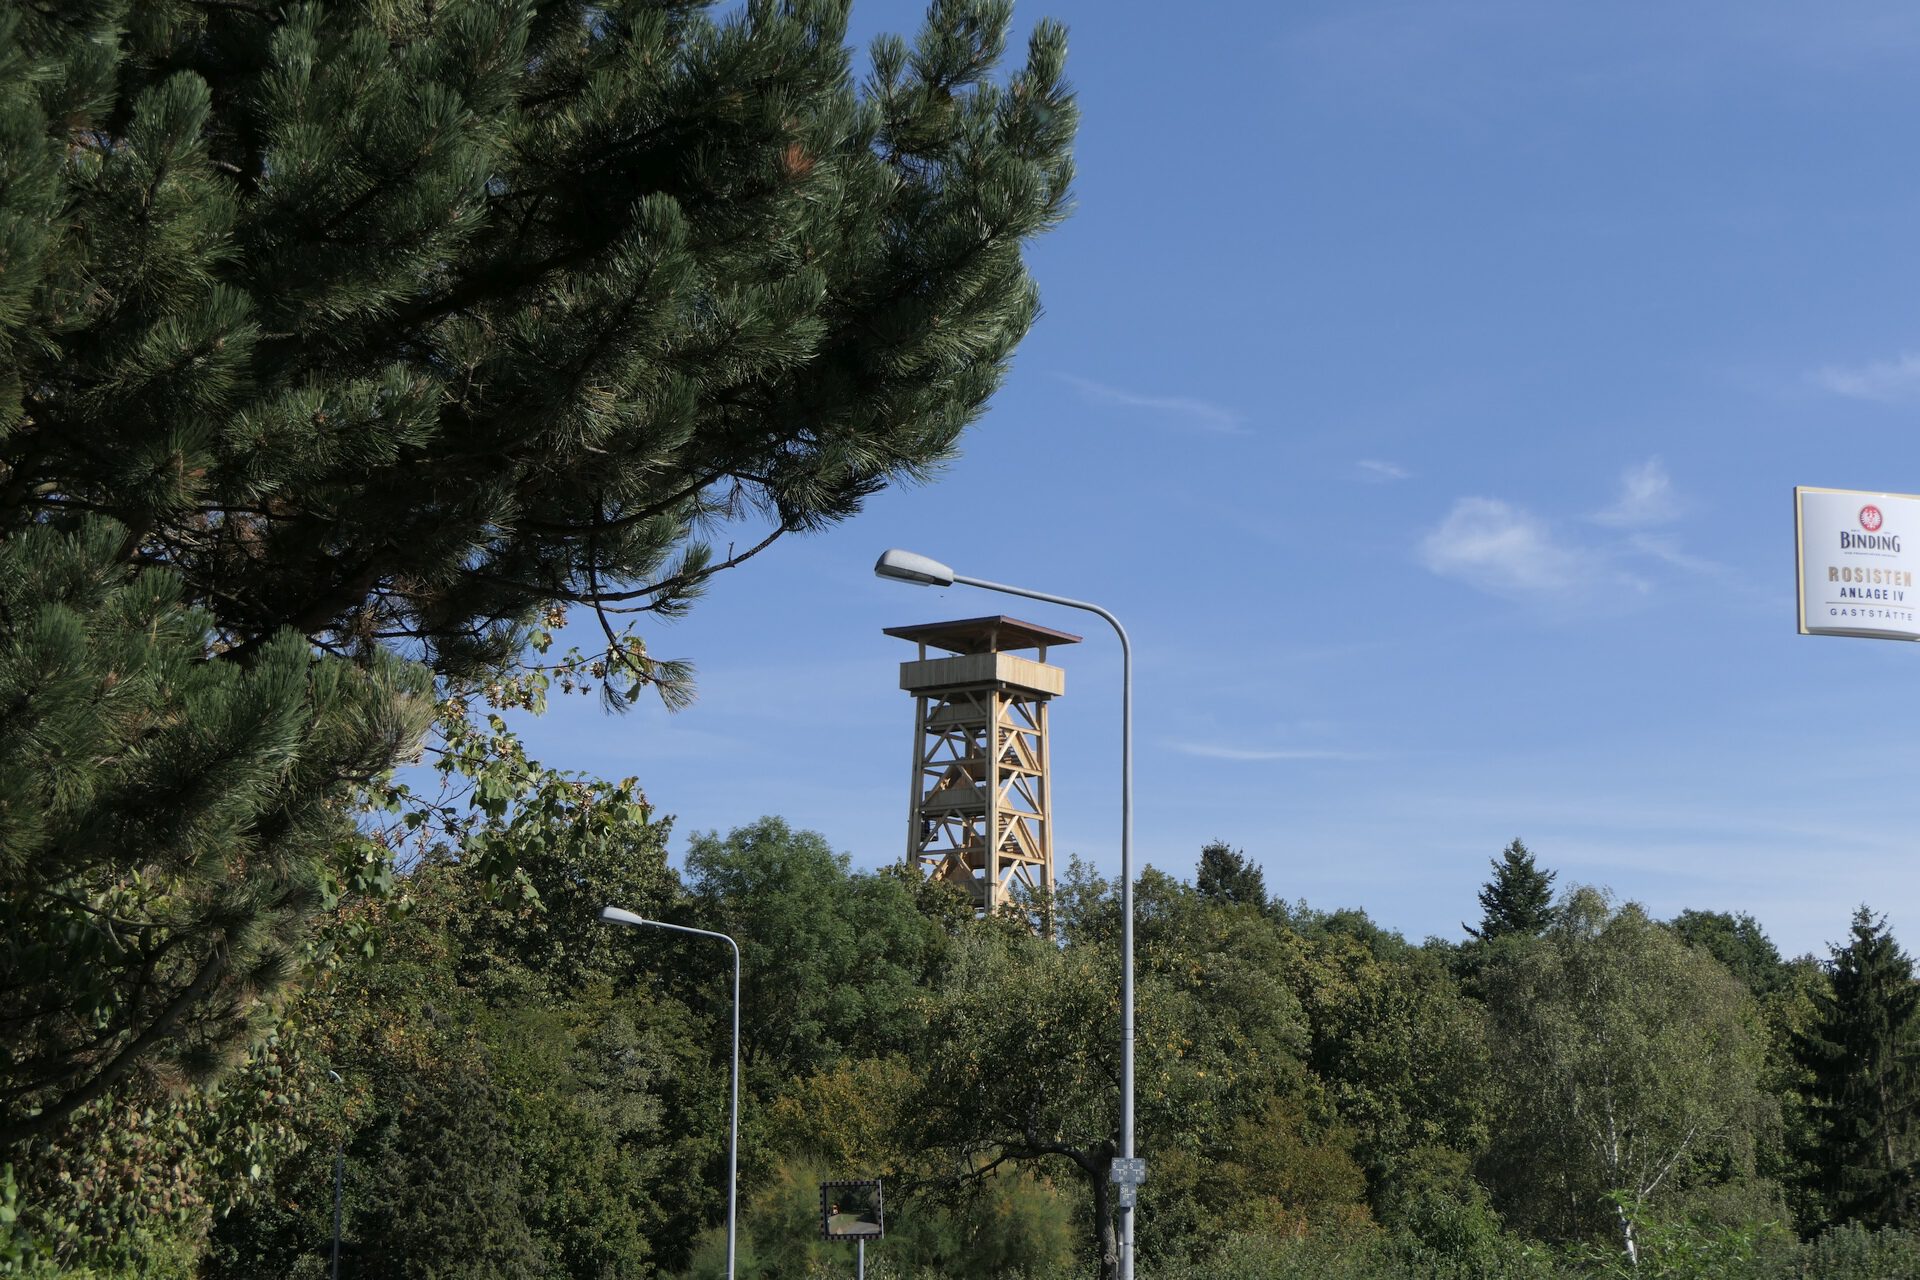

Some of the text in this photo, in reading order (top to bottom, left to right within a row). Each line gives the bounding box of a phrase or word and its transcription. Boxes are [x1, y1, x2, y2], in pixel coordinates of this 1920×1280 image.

[1840, 531, 1901, 553] BINDING
[1828, 566, 1912, 587] ROSISTEN
[1840, 587, 1904, 602] ANLAGE IV
[1830, 608, 1913, 621] GASTSTÄTTE
